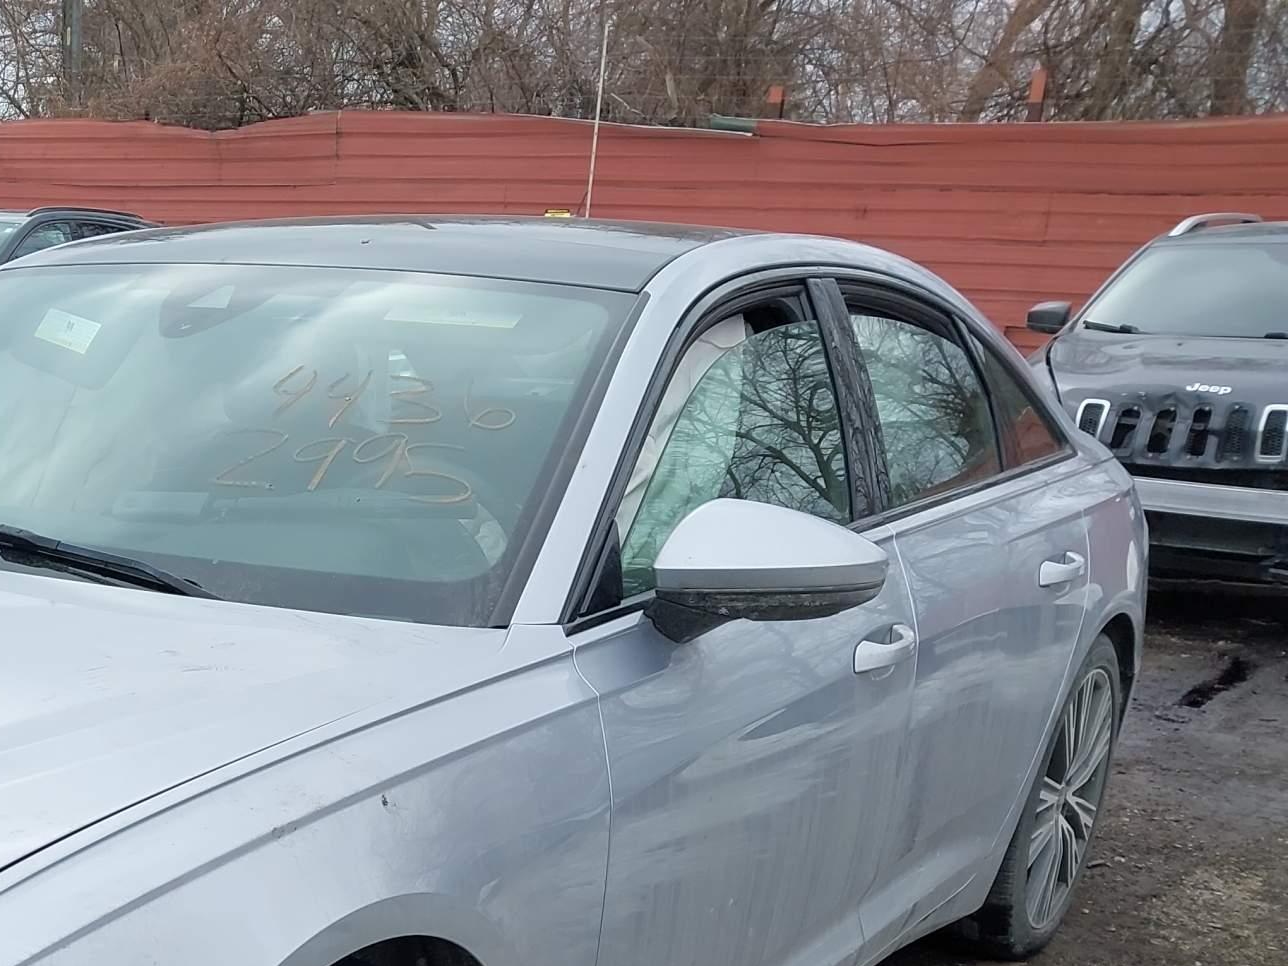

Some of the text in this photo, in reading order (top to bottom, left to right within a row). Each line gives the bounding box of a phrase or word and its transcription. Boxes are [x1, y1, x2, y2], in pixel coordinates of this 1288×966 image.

[272, 364, 517, 431] 4436
[1186, 383, 1232, 395] Jeep
[211, 428, 472, 504] 2995
